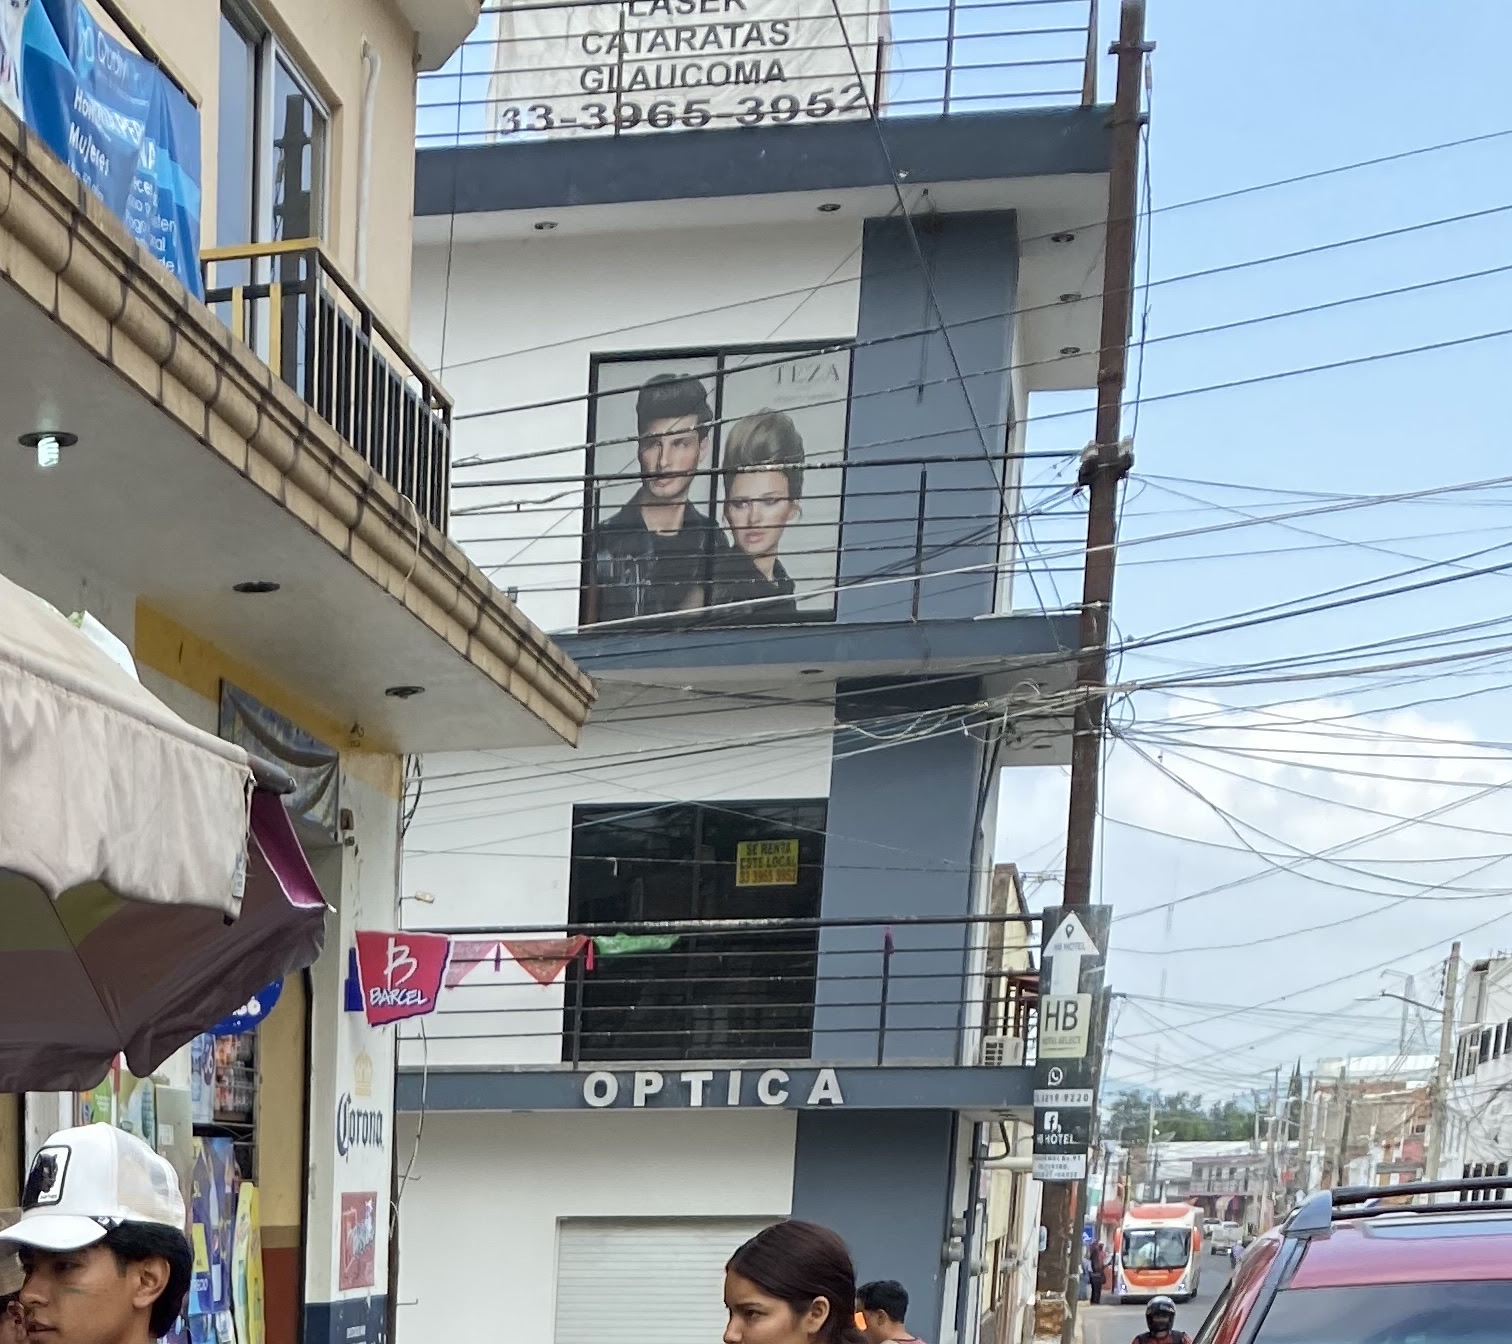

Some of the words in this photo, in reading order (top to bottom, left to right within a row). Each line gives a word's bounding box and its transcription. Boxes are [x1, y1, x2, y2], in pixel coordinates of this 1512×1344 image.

[581, 20, 790, 55] CATARATAS
[580, 58, 788, 94] GLAUCOMA
[501, 82, 868, 134] 33-3965-3952
[370, 986, 428, 1006] BARCEL
[1045, 1000, 1078, 1031] HB
[583, 1068, 844, 1107] OPTICA
[336, 1092, 384, 1164] Corona
